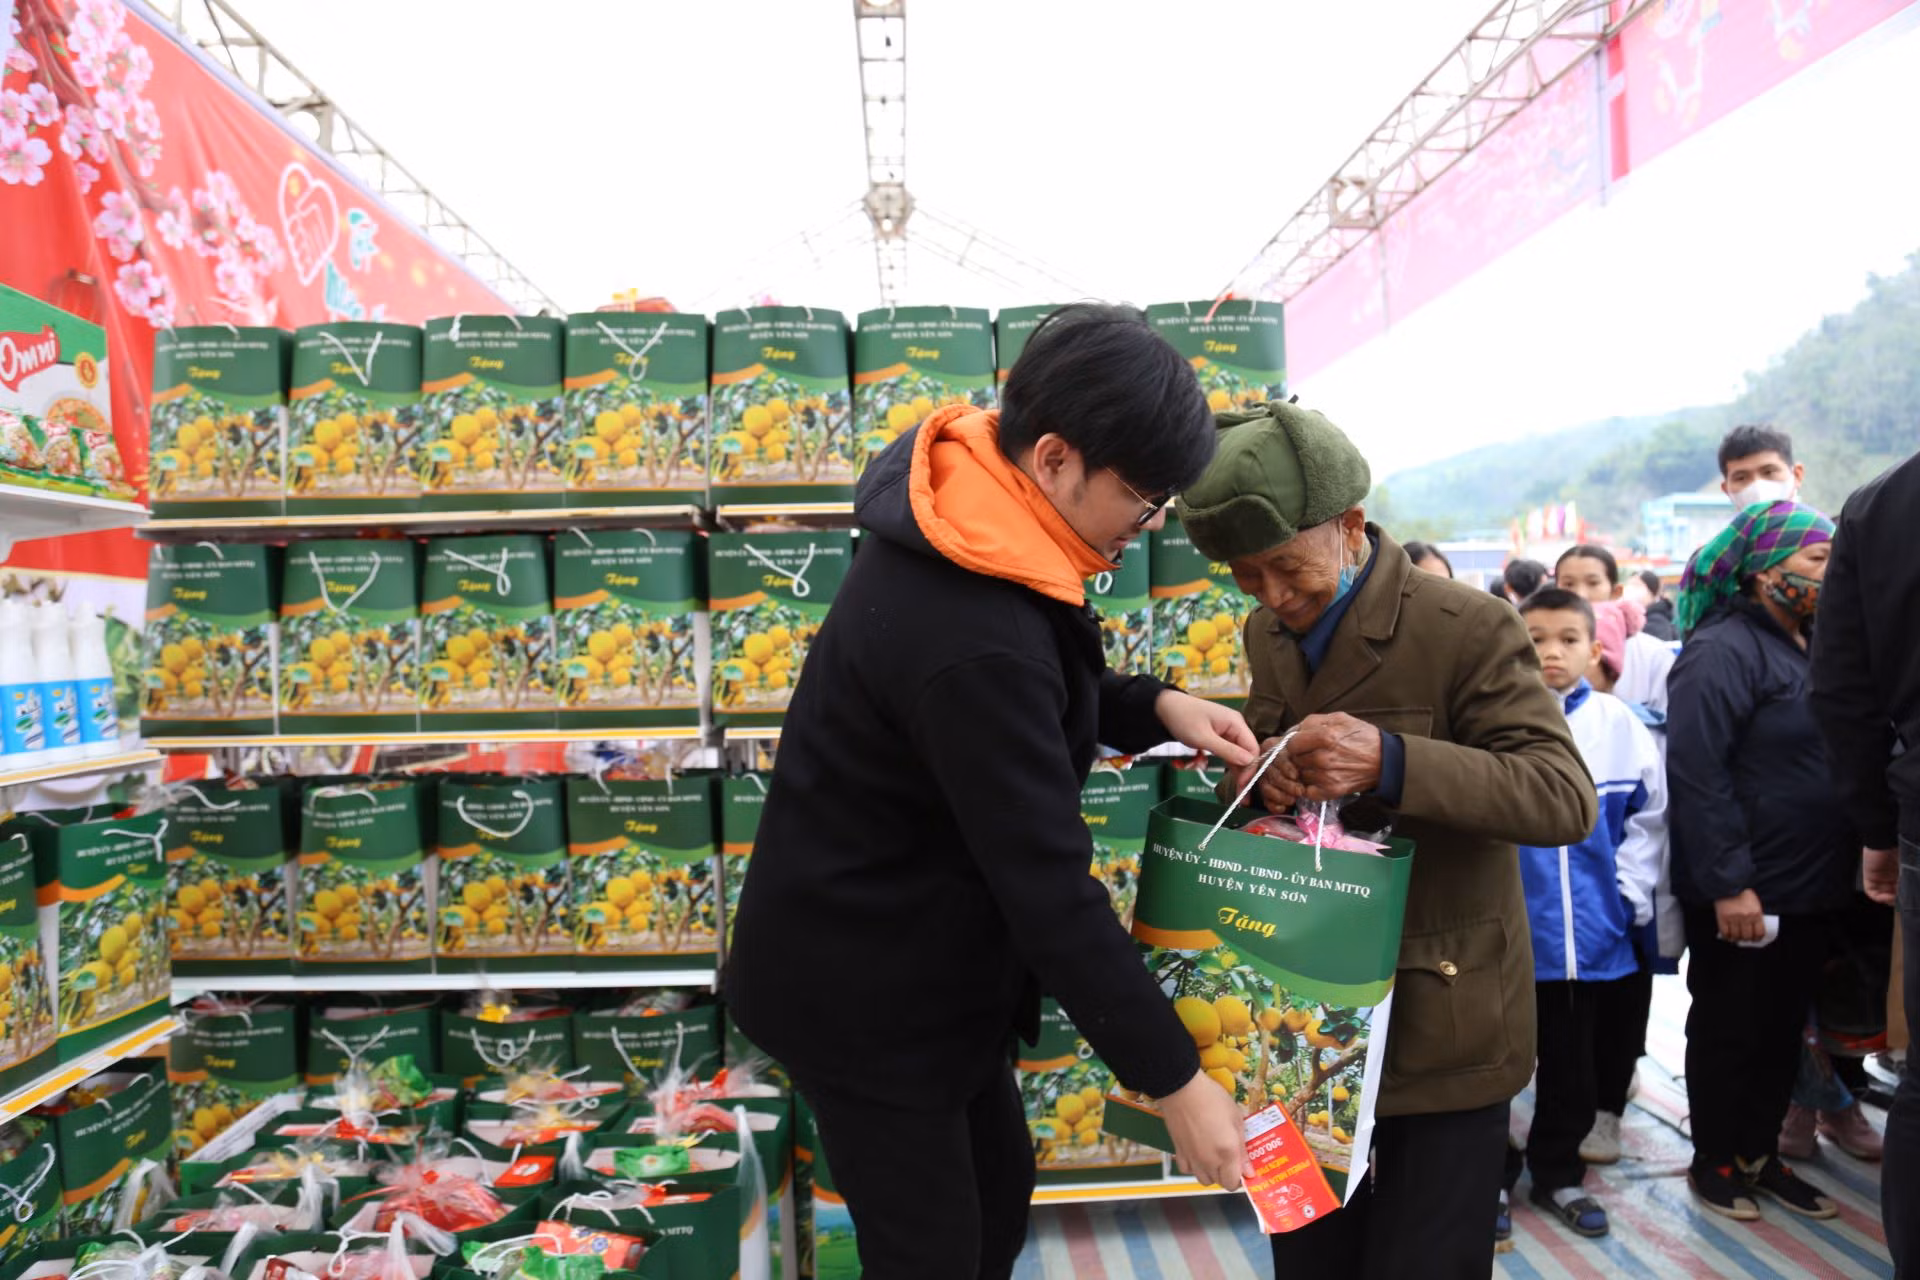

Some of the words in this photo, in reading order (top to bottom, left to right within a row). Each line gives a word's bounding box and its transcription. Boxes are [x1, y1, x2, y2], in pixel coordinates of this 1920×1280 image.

[0, 331, 56, 381] Omni
[1153, 843, 1183, 861] HUYỆN
[1185, 851, 1201, 864] ỦY
[1208, 858, 1242, 873] HĐND
[1250, 866, 1283, 881] UBND
[1291, 871, 1308, 886] ỦY
[1309, 877, 1333, 890] BAN
[1334, 881, 1371, 899] MTTQ
[1198, 873, 1244, 892] HUYỆN
[1249, 883, 1277, 898] YÊN
[1280, 890, 1309, 904] SƠN
[1218, 907, 1277, 938] Tặng
